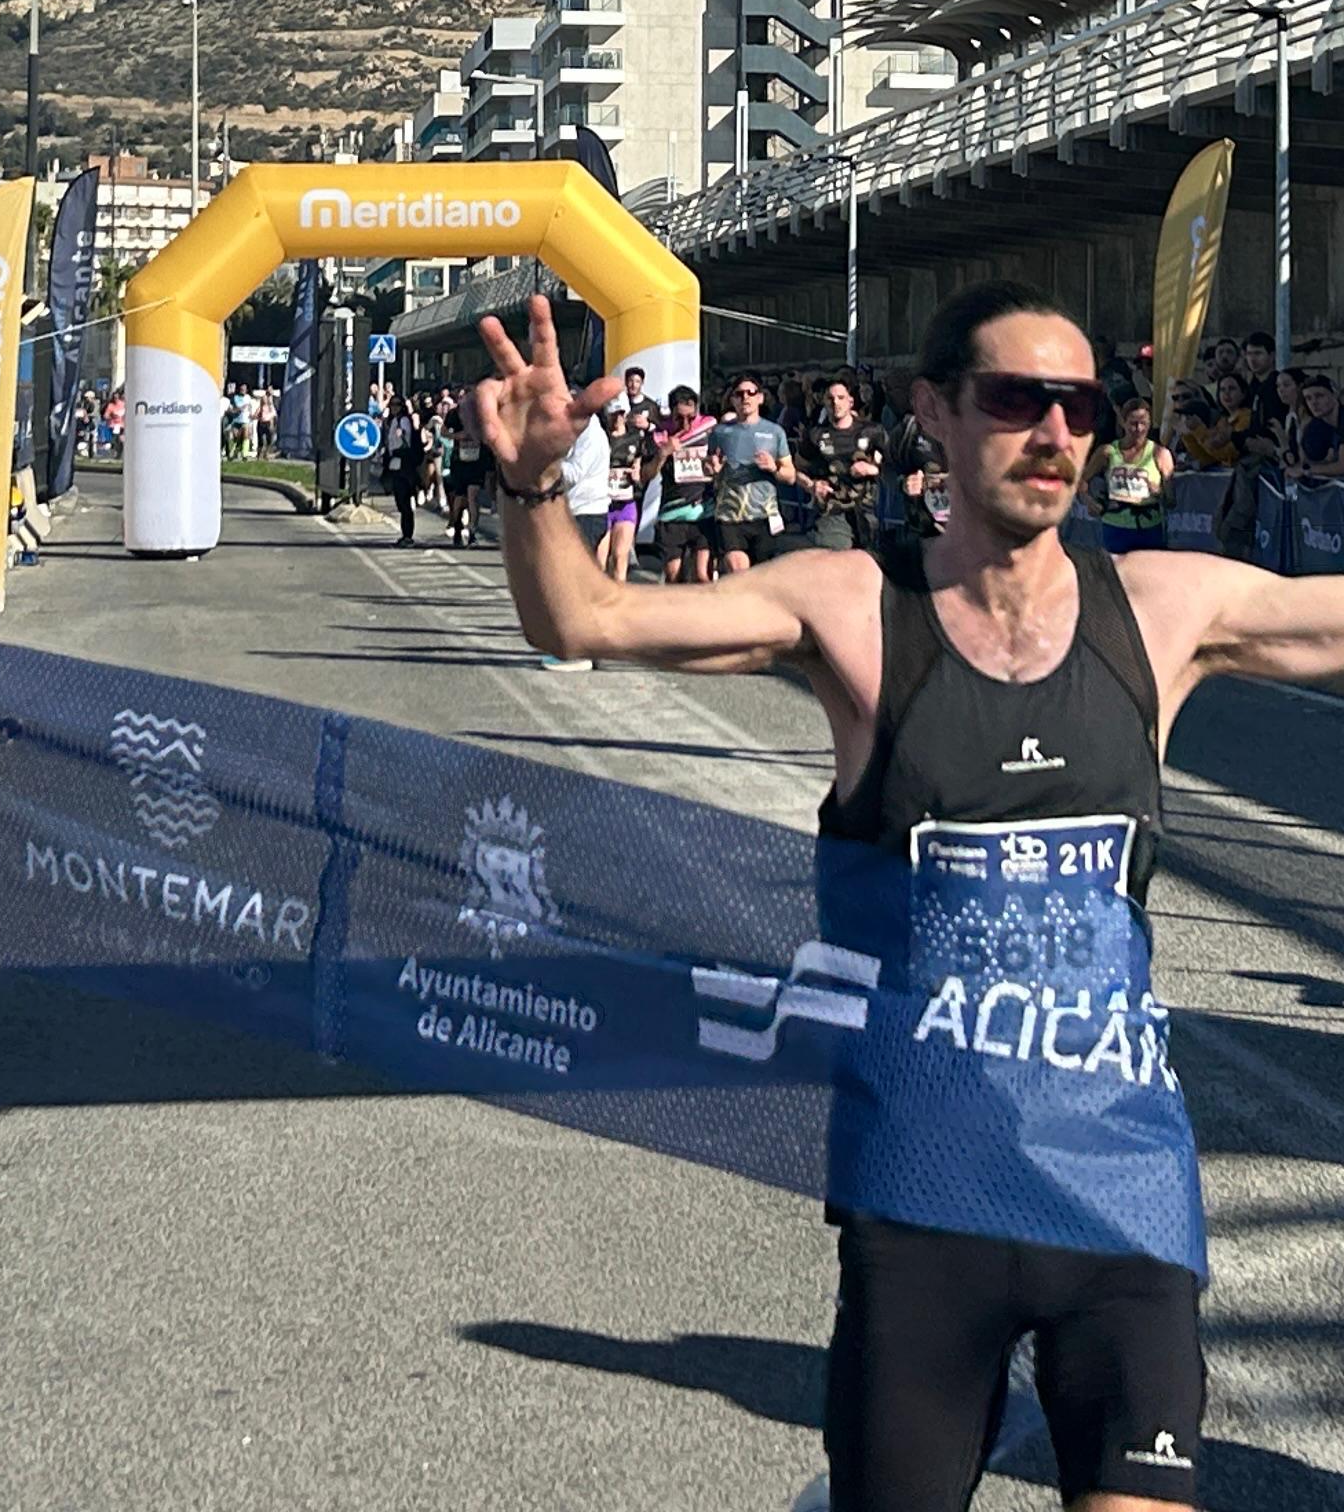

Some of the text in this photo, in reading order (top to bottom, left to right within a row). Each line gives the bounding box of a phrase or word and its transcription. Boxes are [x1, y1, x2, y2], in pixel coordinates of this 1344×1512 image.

[299, 187, 522, 228] Meridiano
[1059, 837, 1114, 876] 21K
[26, 840, 310, 952] MONTEMAR
[398, 955, 598, 1032] Ayuntamiento
[417, 1004, 572, 1074] de Alicante
